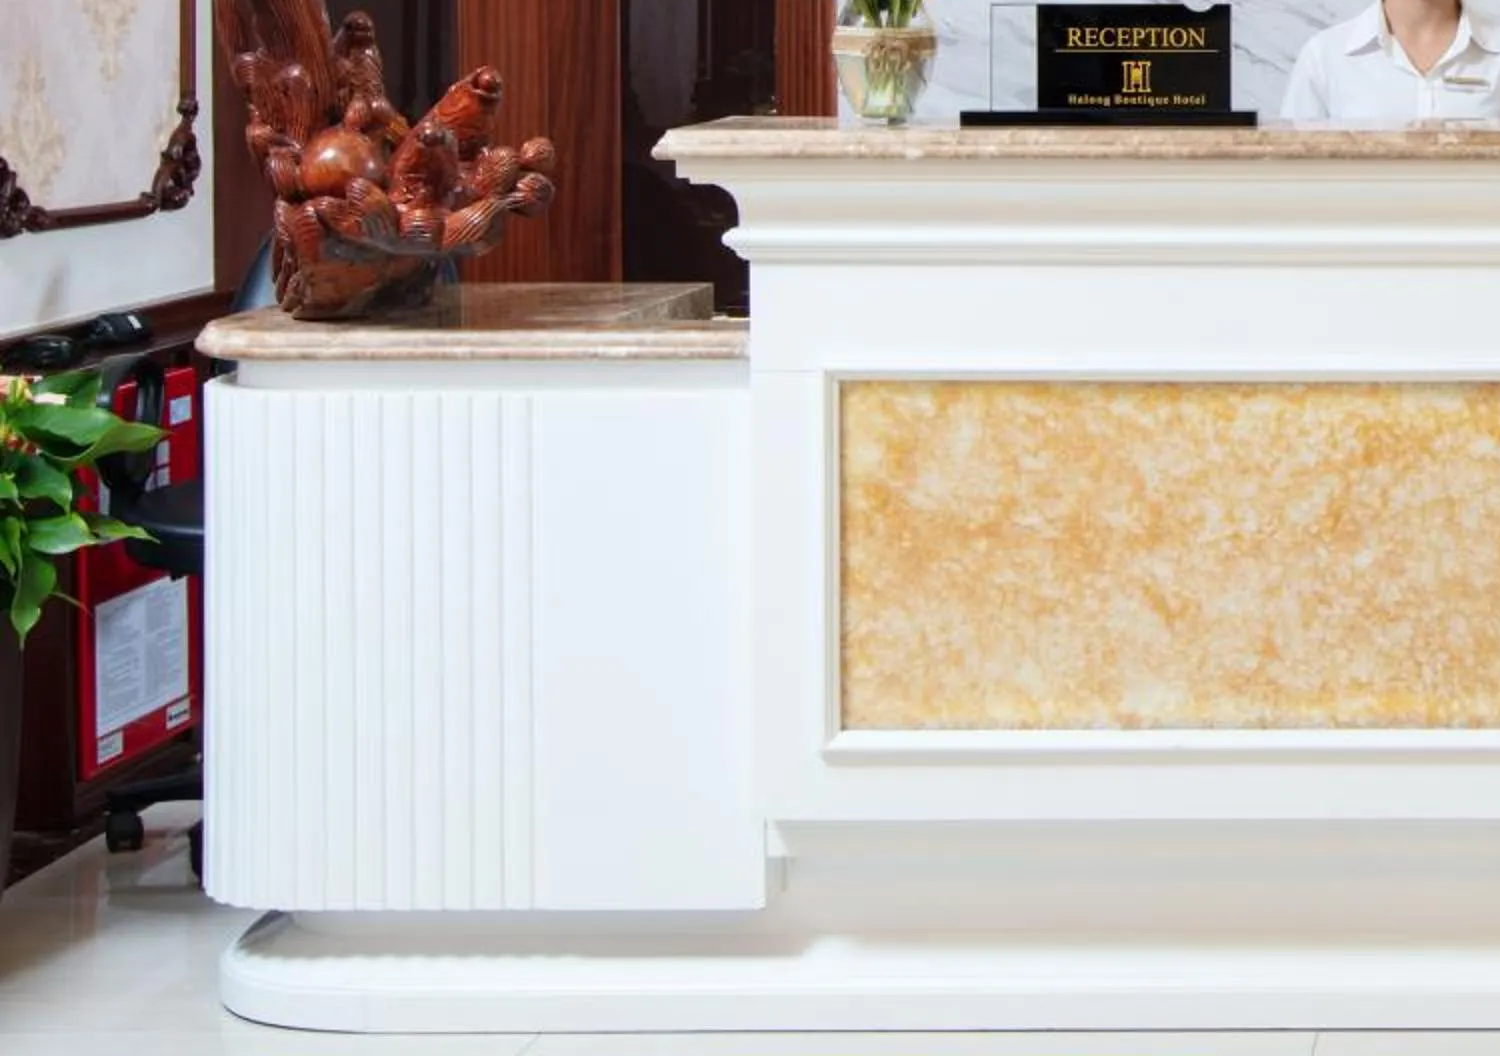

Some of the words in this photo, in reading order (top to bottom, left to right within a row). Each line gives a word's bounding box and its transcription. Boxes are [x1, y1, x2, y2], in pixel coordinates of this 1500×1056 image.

[1066, 26, 1206, 48] RECEPTION
[1067, 93, 1112, 107] Halong
[1114, 93, 1170, 108] Boutique
[1173, 93, 1206, 106] Hotel
